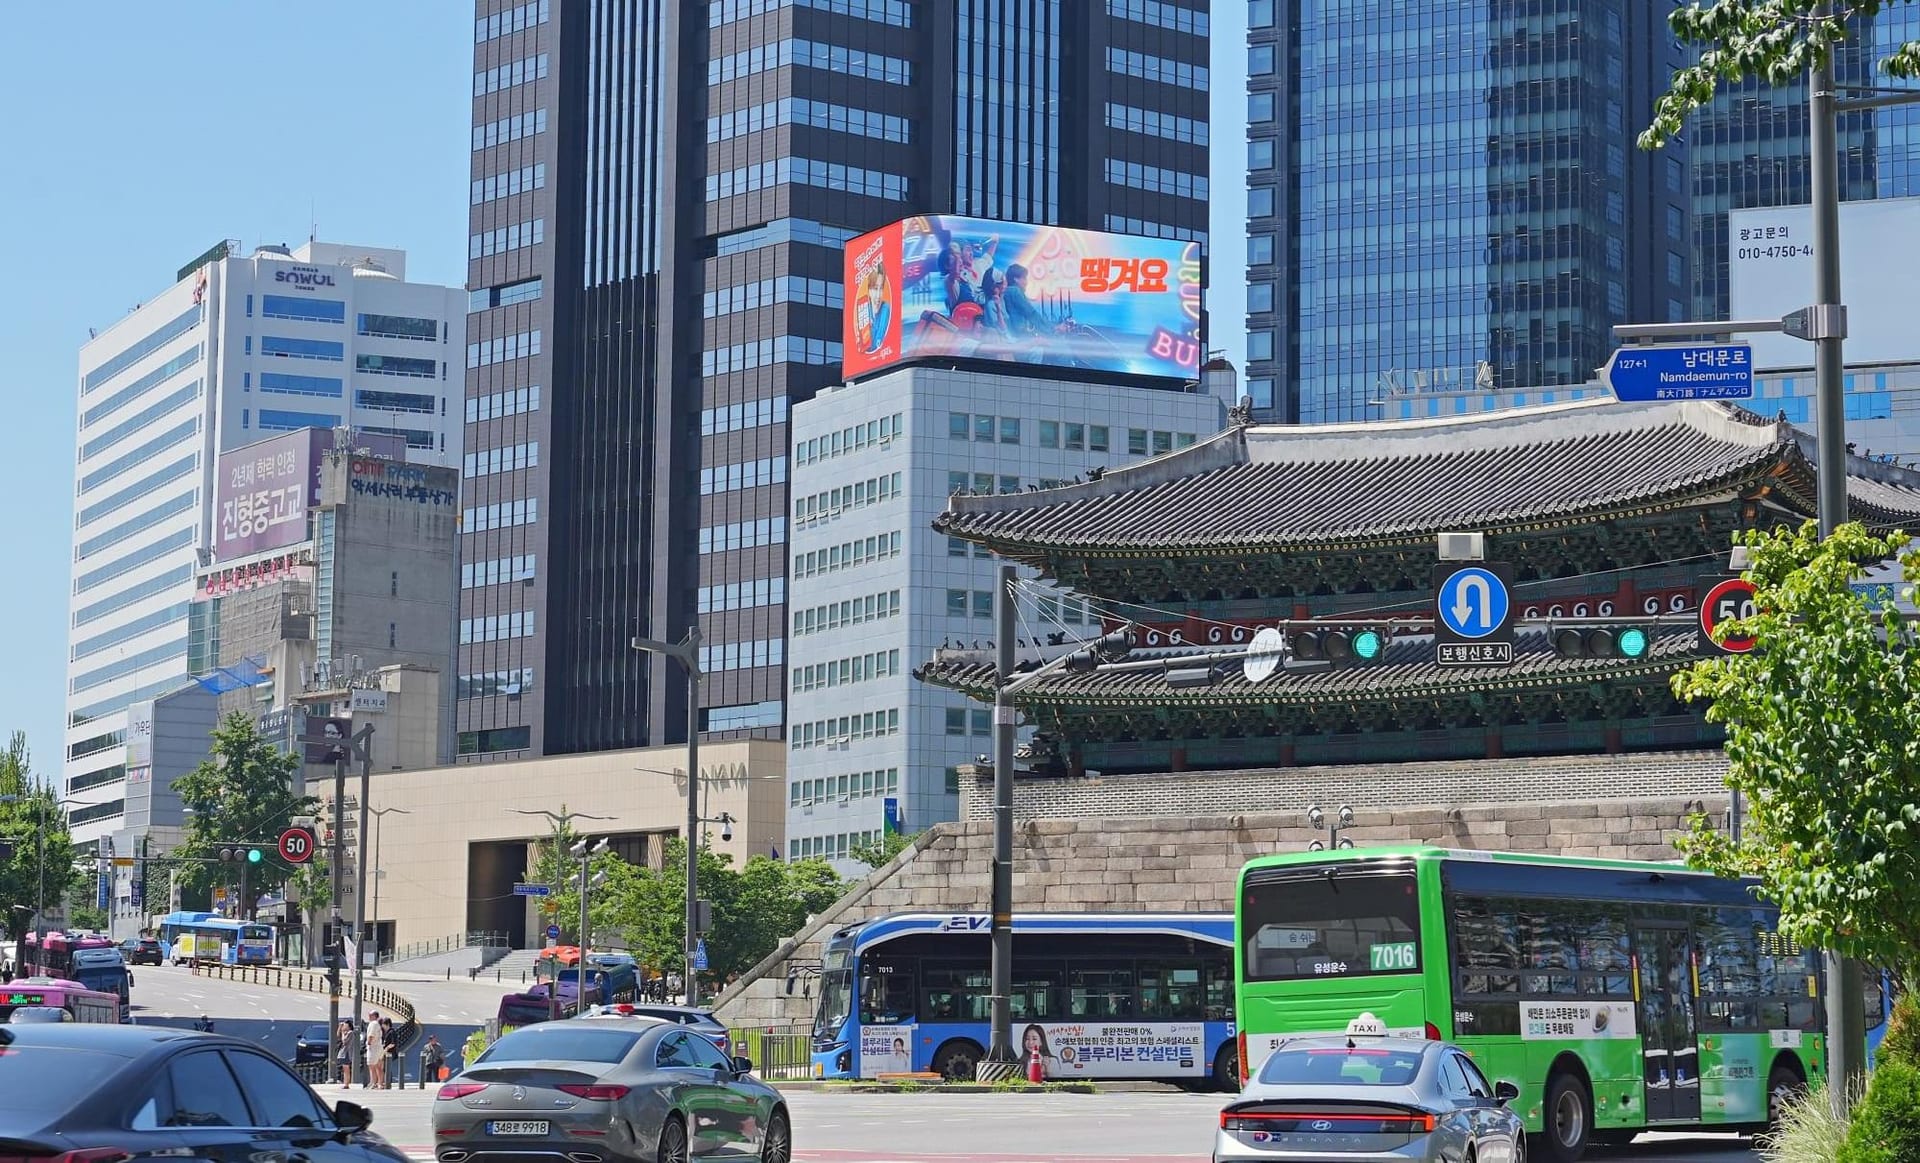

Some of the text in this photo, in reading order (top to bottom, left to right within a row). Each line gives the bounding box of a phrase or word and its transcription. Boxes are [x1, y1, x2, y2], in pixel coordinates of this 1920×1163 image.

[1740, 226, 1788, 240] 광고문의
[1080, 258, 1168, 292] 땡겨요
[1152, 331, 1200, 369] BU
[1619, 359, 1634, 369] 127
[1682, 350, 1748, 369] 남대문로
[1660, 370, 1748, 383] Namdaemun-ro
[231, 461, 255, 489] 2년제
[256, 455, 275, 481] 학력
[277, 448, 296, 477] 인정
[223, 483, 302, 541] 진형중고교
[1719, 599, 1758, 622] 50
[1441, 645, 1508, 661] 보행신호시
[286, 837, 305, 853] 50
[1373, 944, 1414, 968] 7016
[878, 966, 893, 974] 7013
[1314, 961, 1348, 974] 유성운수
[1102, 1027, 1153, 1036] 불완전판매 0%
[1353, 1025, 1377, 1033] TAXI
[862, 1037, 892, 1047] 블루리본
[1100, 1037, 1115, 1046] 인증
[1117, 1037, 1138, 1046] 최고의
[1139, 1037, 1154, 1046] 보험
[1156, 1037, 1199, 1046] 스페셜리스트
[1077, 1046, 1194, 1062] 블루리본 컨설턴트
[522, 1122, 546, 1133] 9918
